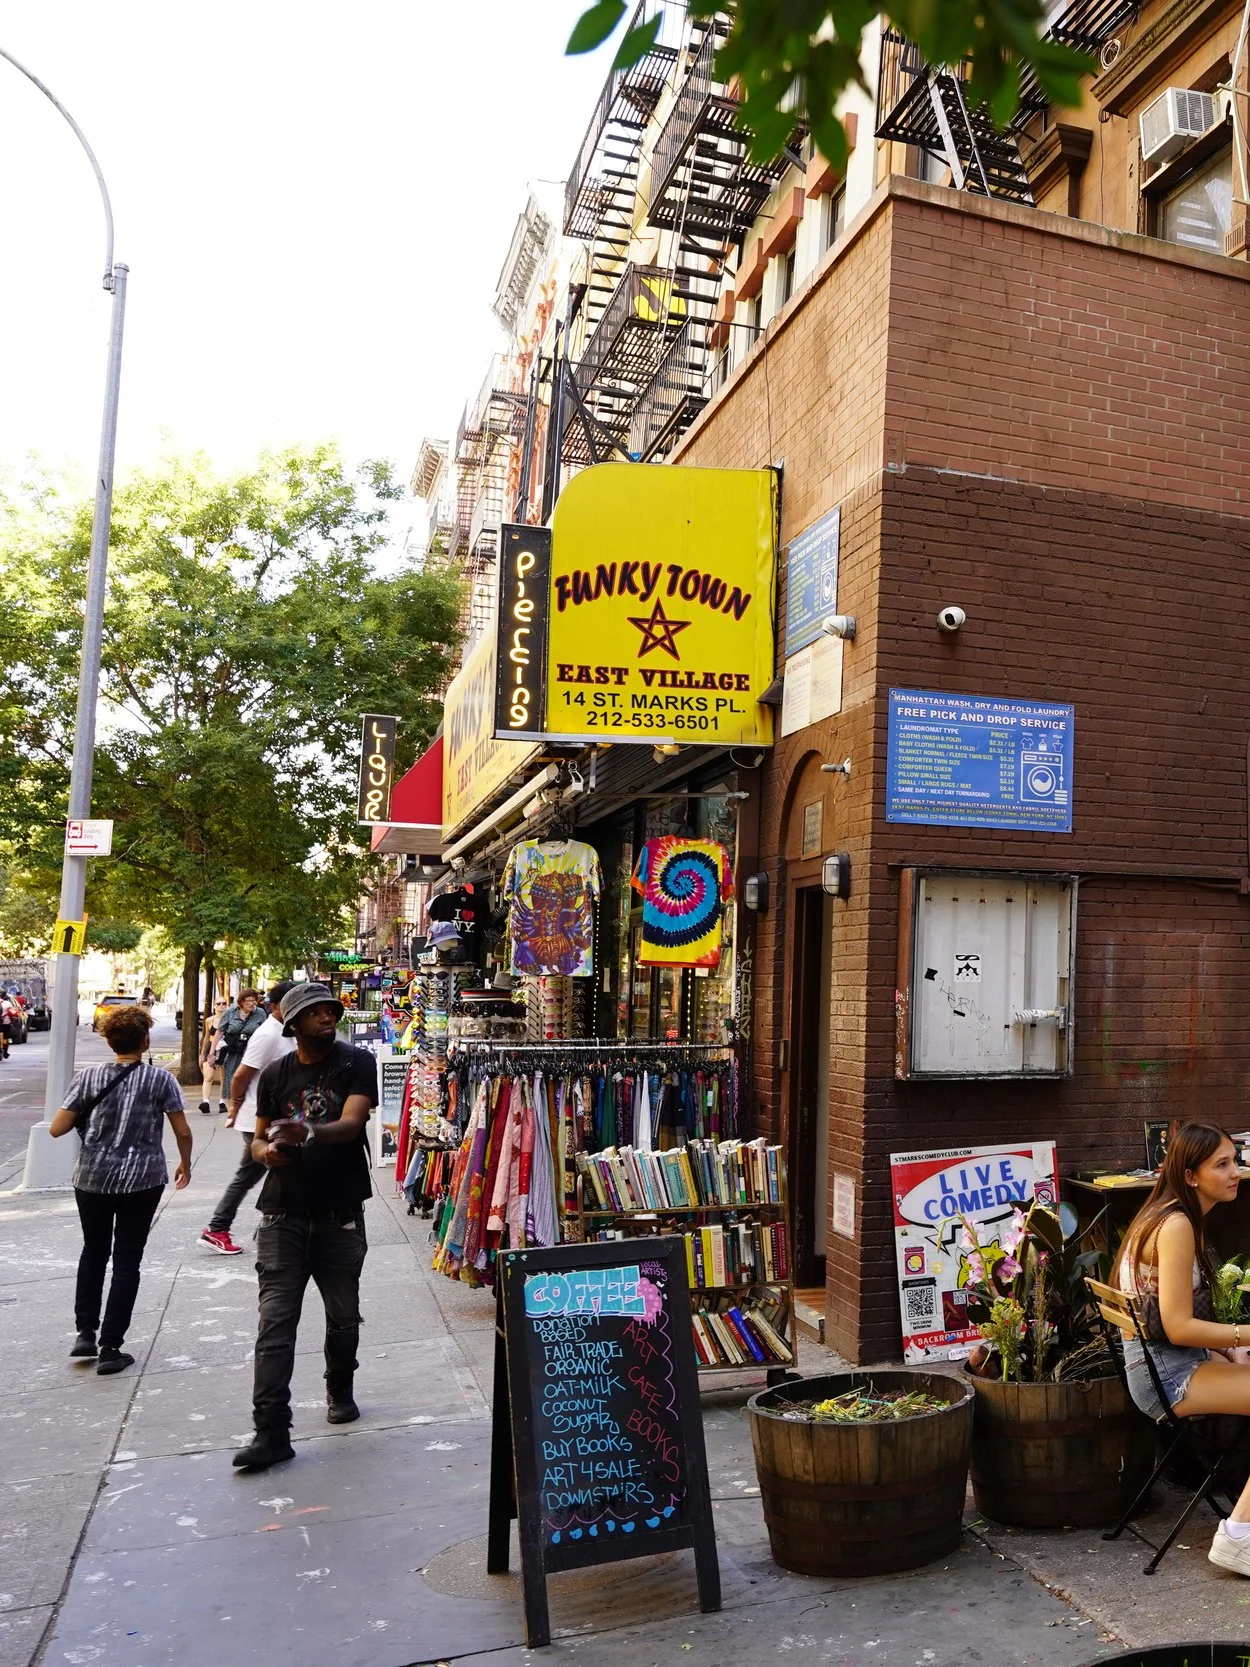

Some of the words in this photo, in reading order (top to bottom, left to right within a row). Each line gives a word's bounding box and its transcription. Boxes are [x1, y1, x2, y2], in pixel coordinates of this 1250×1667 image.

[555, 561, 662, 613] FUNKY
[666, 564, 752, 622] TOWN
[556, 664, 629, 686] EAST
[638, 668, 750, 691] VILLAGE
[562, 691, 586, 706] 14
[593, 692, 623, 708] ST.
[631, 694, 708, 711] MARKS
[715, 698, 746, 713] PL.
[894, 694, 945, 704] MANHATTAN
[948, 700, 972, 708] WASH,
[993, 703, 1009, 711] AND
[1034, 708, 1069, 716] LAUNDRY
[586, 711, 719, 730] 212-533-6501
[898, 707, 926, 717] FREE
[930, 710, 957, 720] PICK
[961, 713, 984, 722] AND
[987, 715, 1017, 725] DROP
[1020, 718, 1066, 730] SERVICE
[365, 722, 386, 820] LIQUOR
[454, 909, 461, 919] I
[895, 1149, 972, 1162] STMARKSCOMEDYCLUB.COM
[939, 1160, 1014, 1195] LIVE
[924, 1179, 1027, 1220] COMEDY
[641, 1267, 668, 1281] ARTISTS
[524, 1265, 647, 1318] COFFEE
[544, 1341, 577, 1360] FAIR
[576, 1341, 623, 1358] TRADE
[622, 1322, 658, 1365] ART
[545, 1355, 612, 1376] ORGANIC
[544, 1375, 626, 1398] OAT-MILK
[628, 1366, 663, 1415] CAFE
[542, 1399, 607, 1417] COCONUT
[552, 1412, 620, 1434] SUGAR
[542, 1438, 574, 1460] BUY
[576, 1435, 632, 1455] BOOKS
[626, 1408, 680, 1482] BOOKS
[543, 1462, 578, 1488] ART
[581, 1461, 593, 1482] 4
[595, 1459, 642, 1479] SALE
[546, 1482, 654, 1510] DOWNSTAIRS
